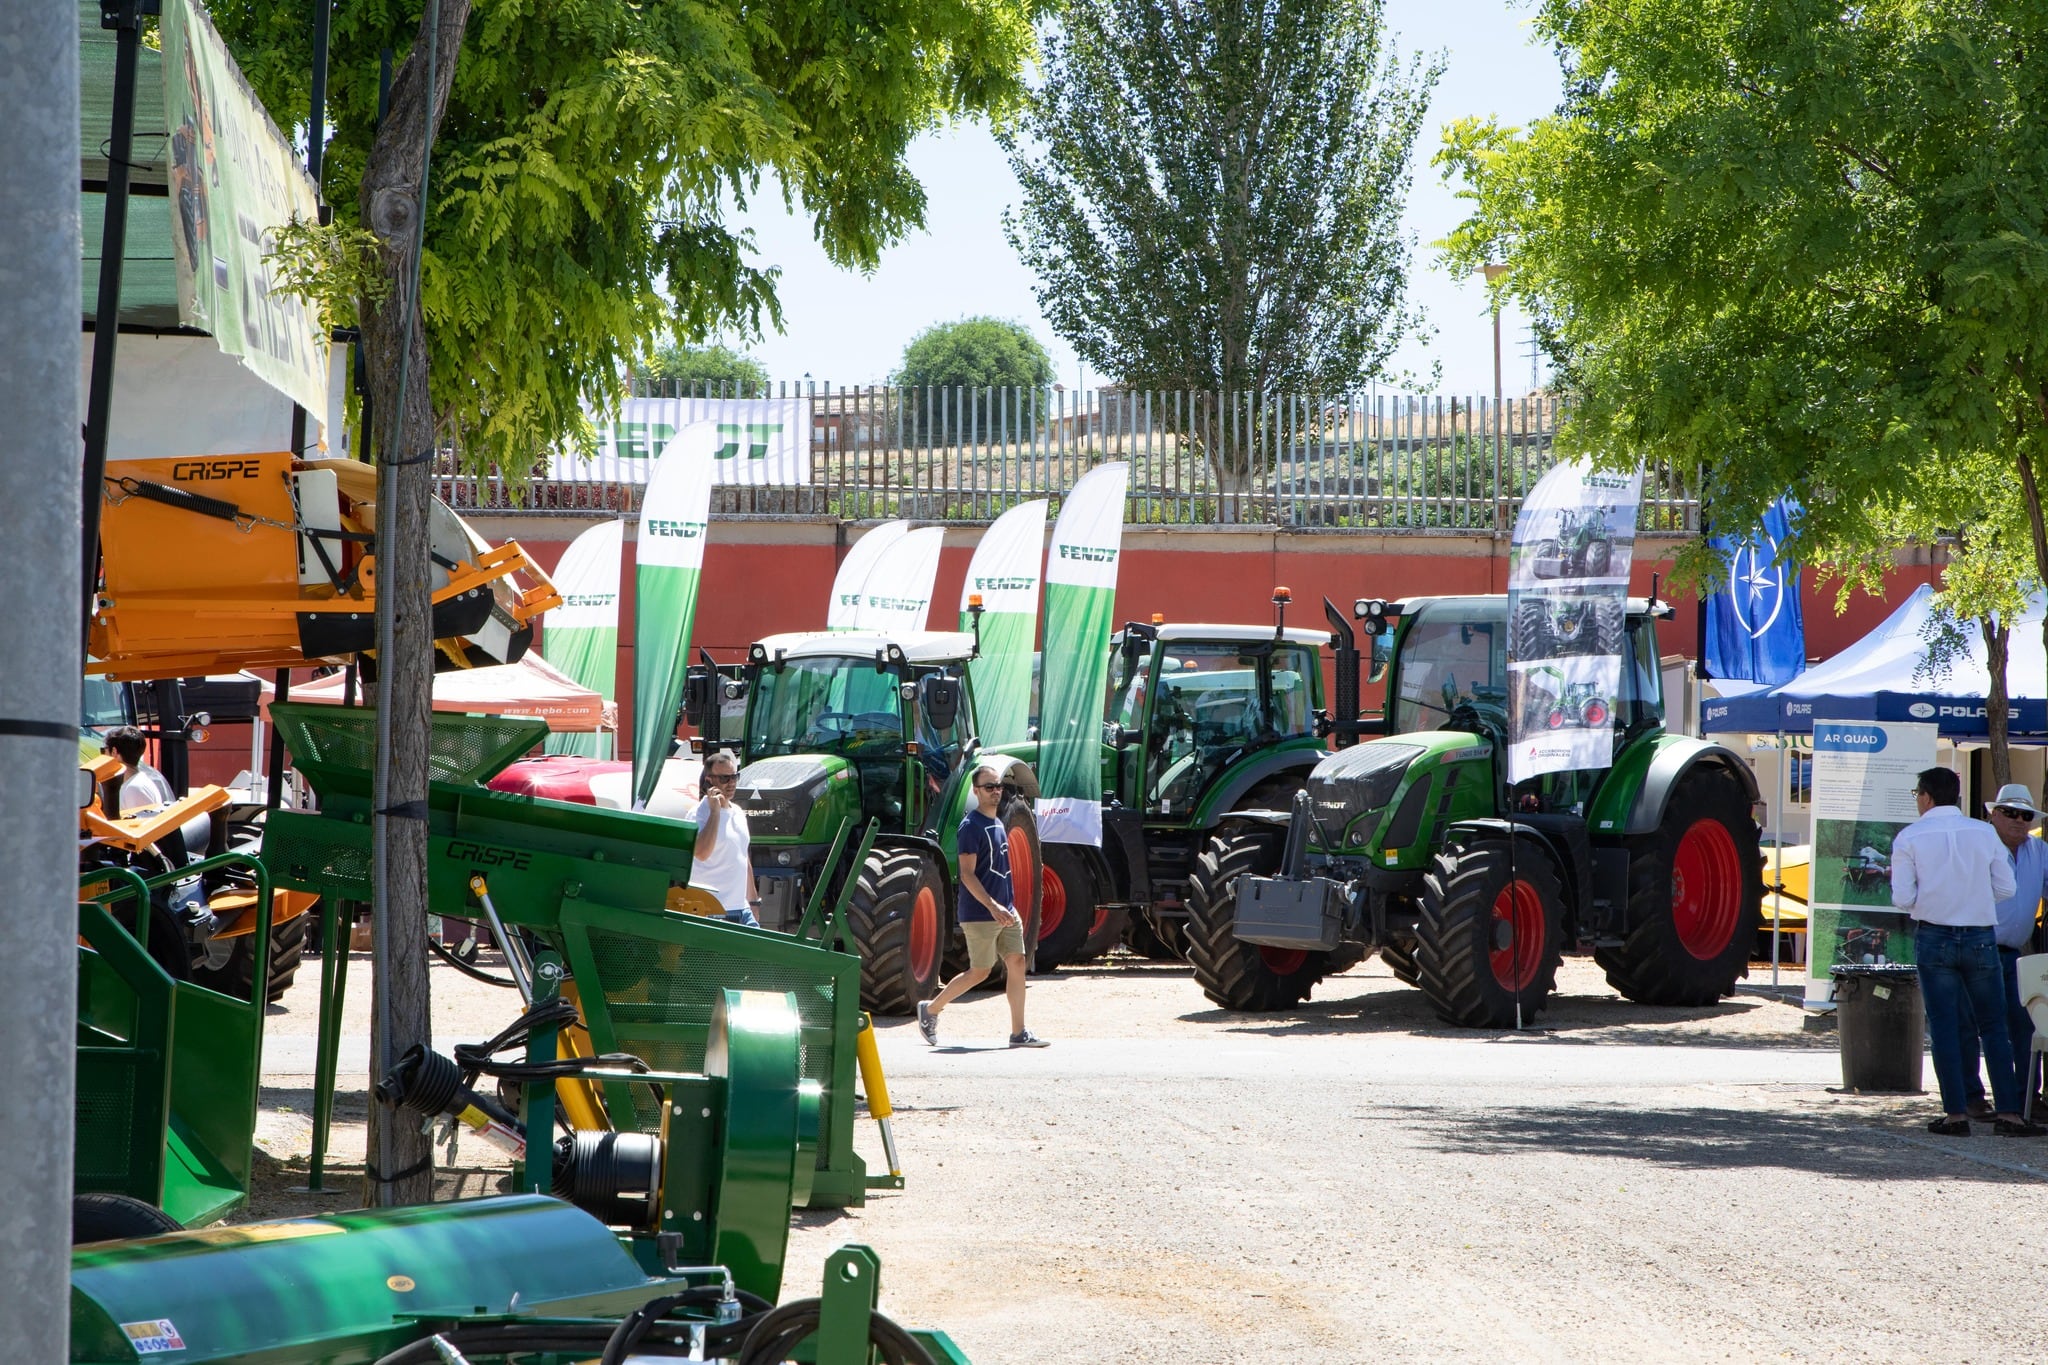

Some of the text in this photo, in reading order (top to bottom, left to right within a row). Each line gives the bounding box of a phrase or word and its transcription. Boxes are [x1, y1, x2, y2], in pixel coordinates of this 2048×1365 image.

[1582, 476, 1631, 489] FENDT
[648, 519, 707, 538] FENDT
[1059, 544, 1117, 562] FENDT
[975, 577, 1036, 590] FENDT
[869, 595, 927, 611] FENDT
[1939, 705, 2020, 719] POLAS
[1823, 734, 1878, 744] AR QUAD
